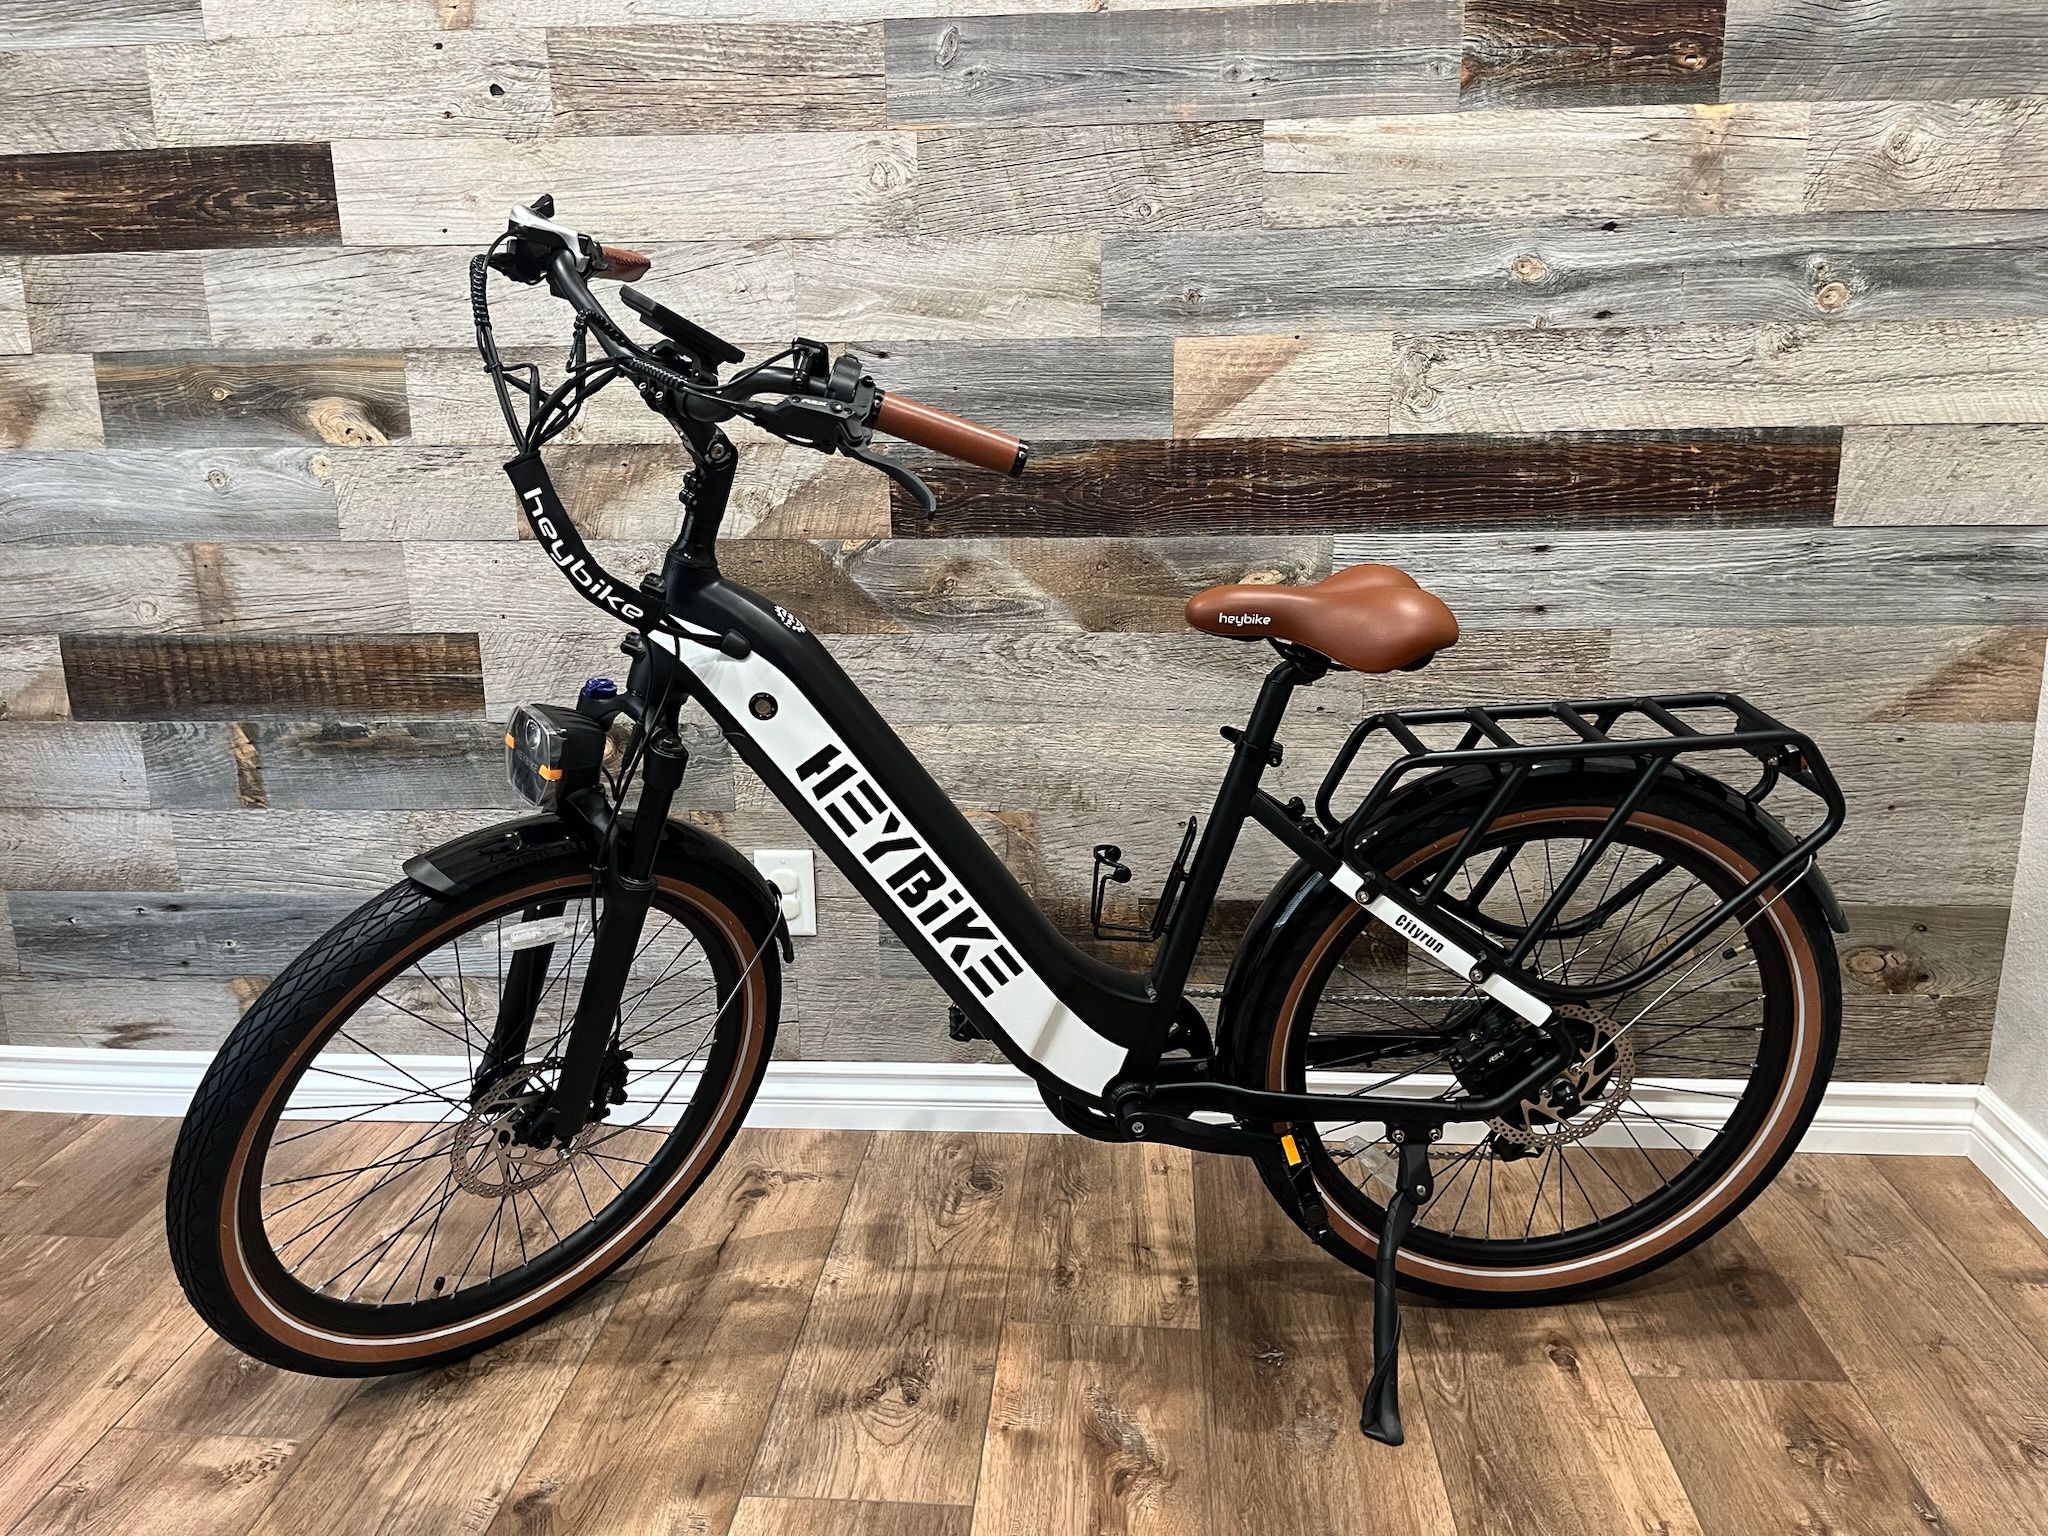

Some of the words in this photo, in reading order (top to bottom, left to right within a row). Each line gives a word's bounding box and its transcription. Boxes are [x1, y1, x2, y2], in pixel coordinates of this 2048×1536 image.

[523, 487, 644, 619] heybike
[1218, 611, 1272, 627] heybike
[1395, 914, 1445, 954] Cityrun
